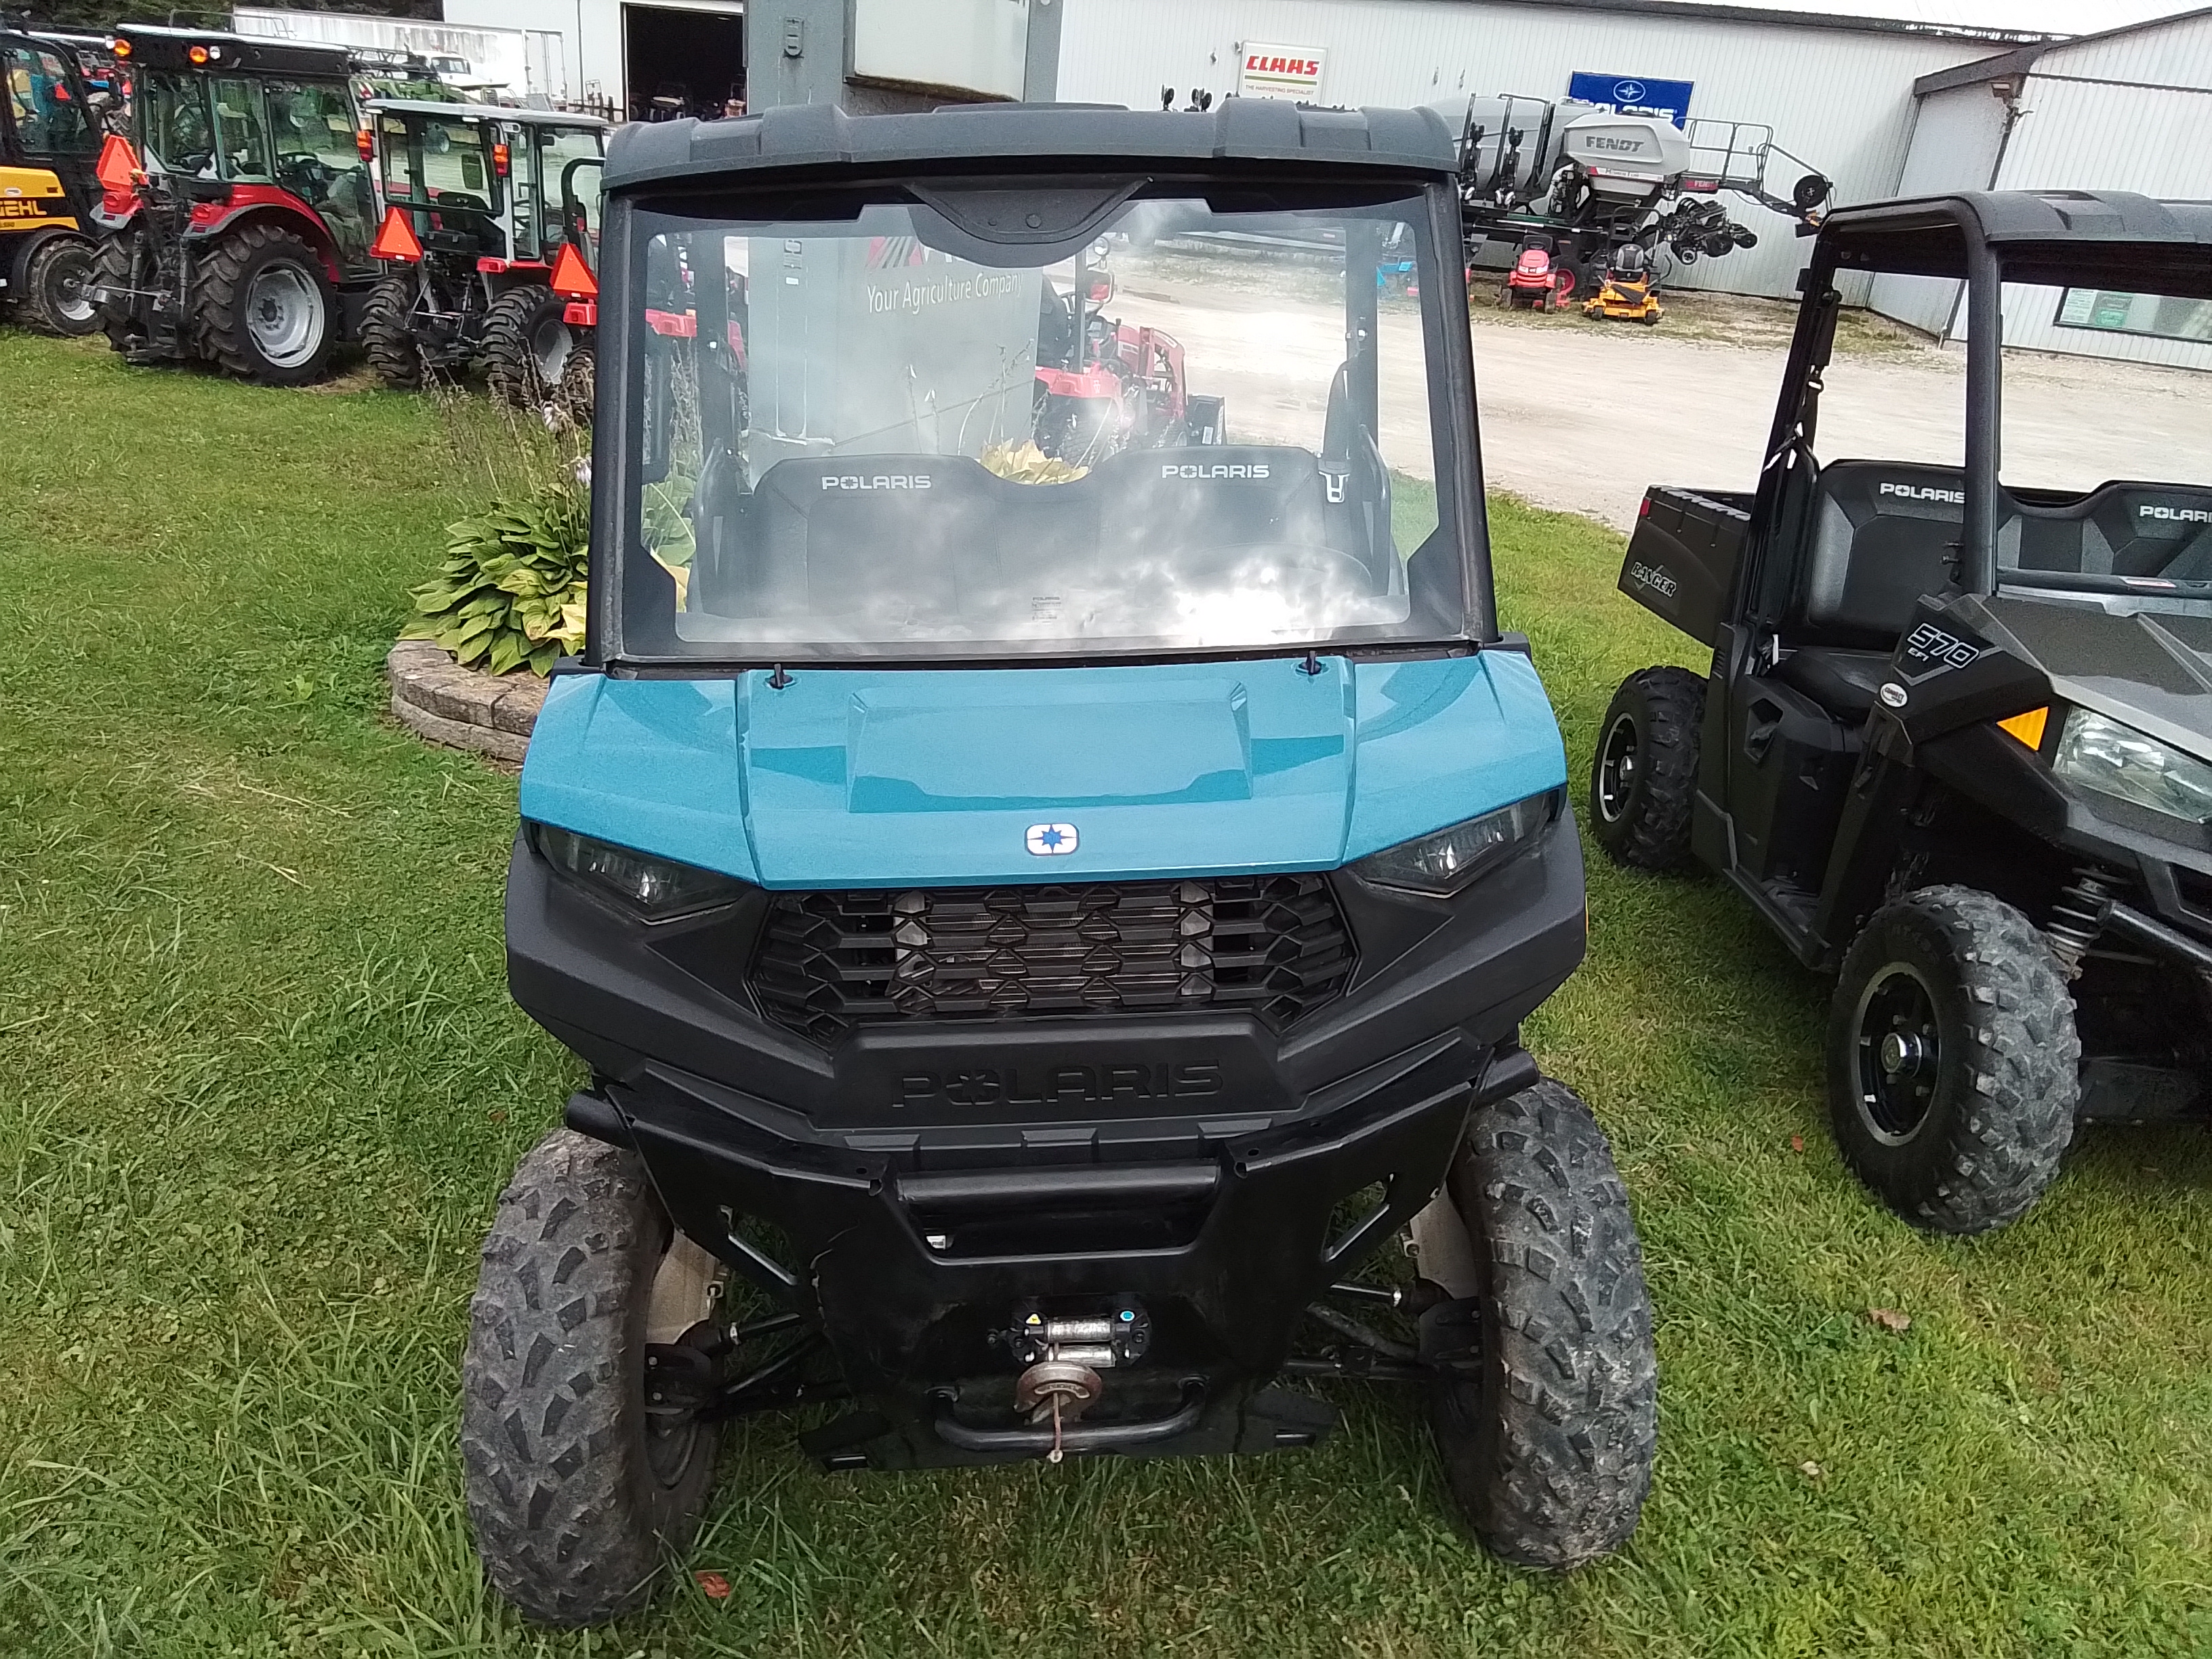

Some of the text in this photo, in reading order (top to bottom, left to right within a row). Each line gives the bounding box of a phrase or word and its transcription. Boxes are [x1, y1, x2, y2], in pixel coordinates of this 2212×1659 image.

[1246, 56, 1320, 75] CLAAS
[1586, 136, 1645, 152] FENDT
[867, 272, 1023, 315] Your Agriculture Company
[1162, 464, 1270, 478] POLARIS
[821, 475, 932, 490] POLARIS
[1879, 483, 1965, 504] POLARIS
[1631, 561, 1677, 597] RANGER
[1906, 622, 1980, 669] 570
[1907, 647, 1929, 662] EFI
[891, 1059, 1223, 1108] POLARIS
